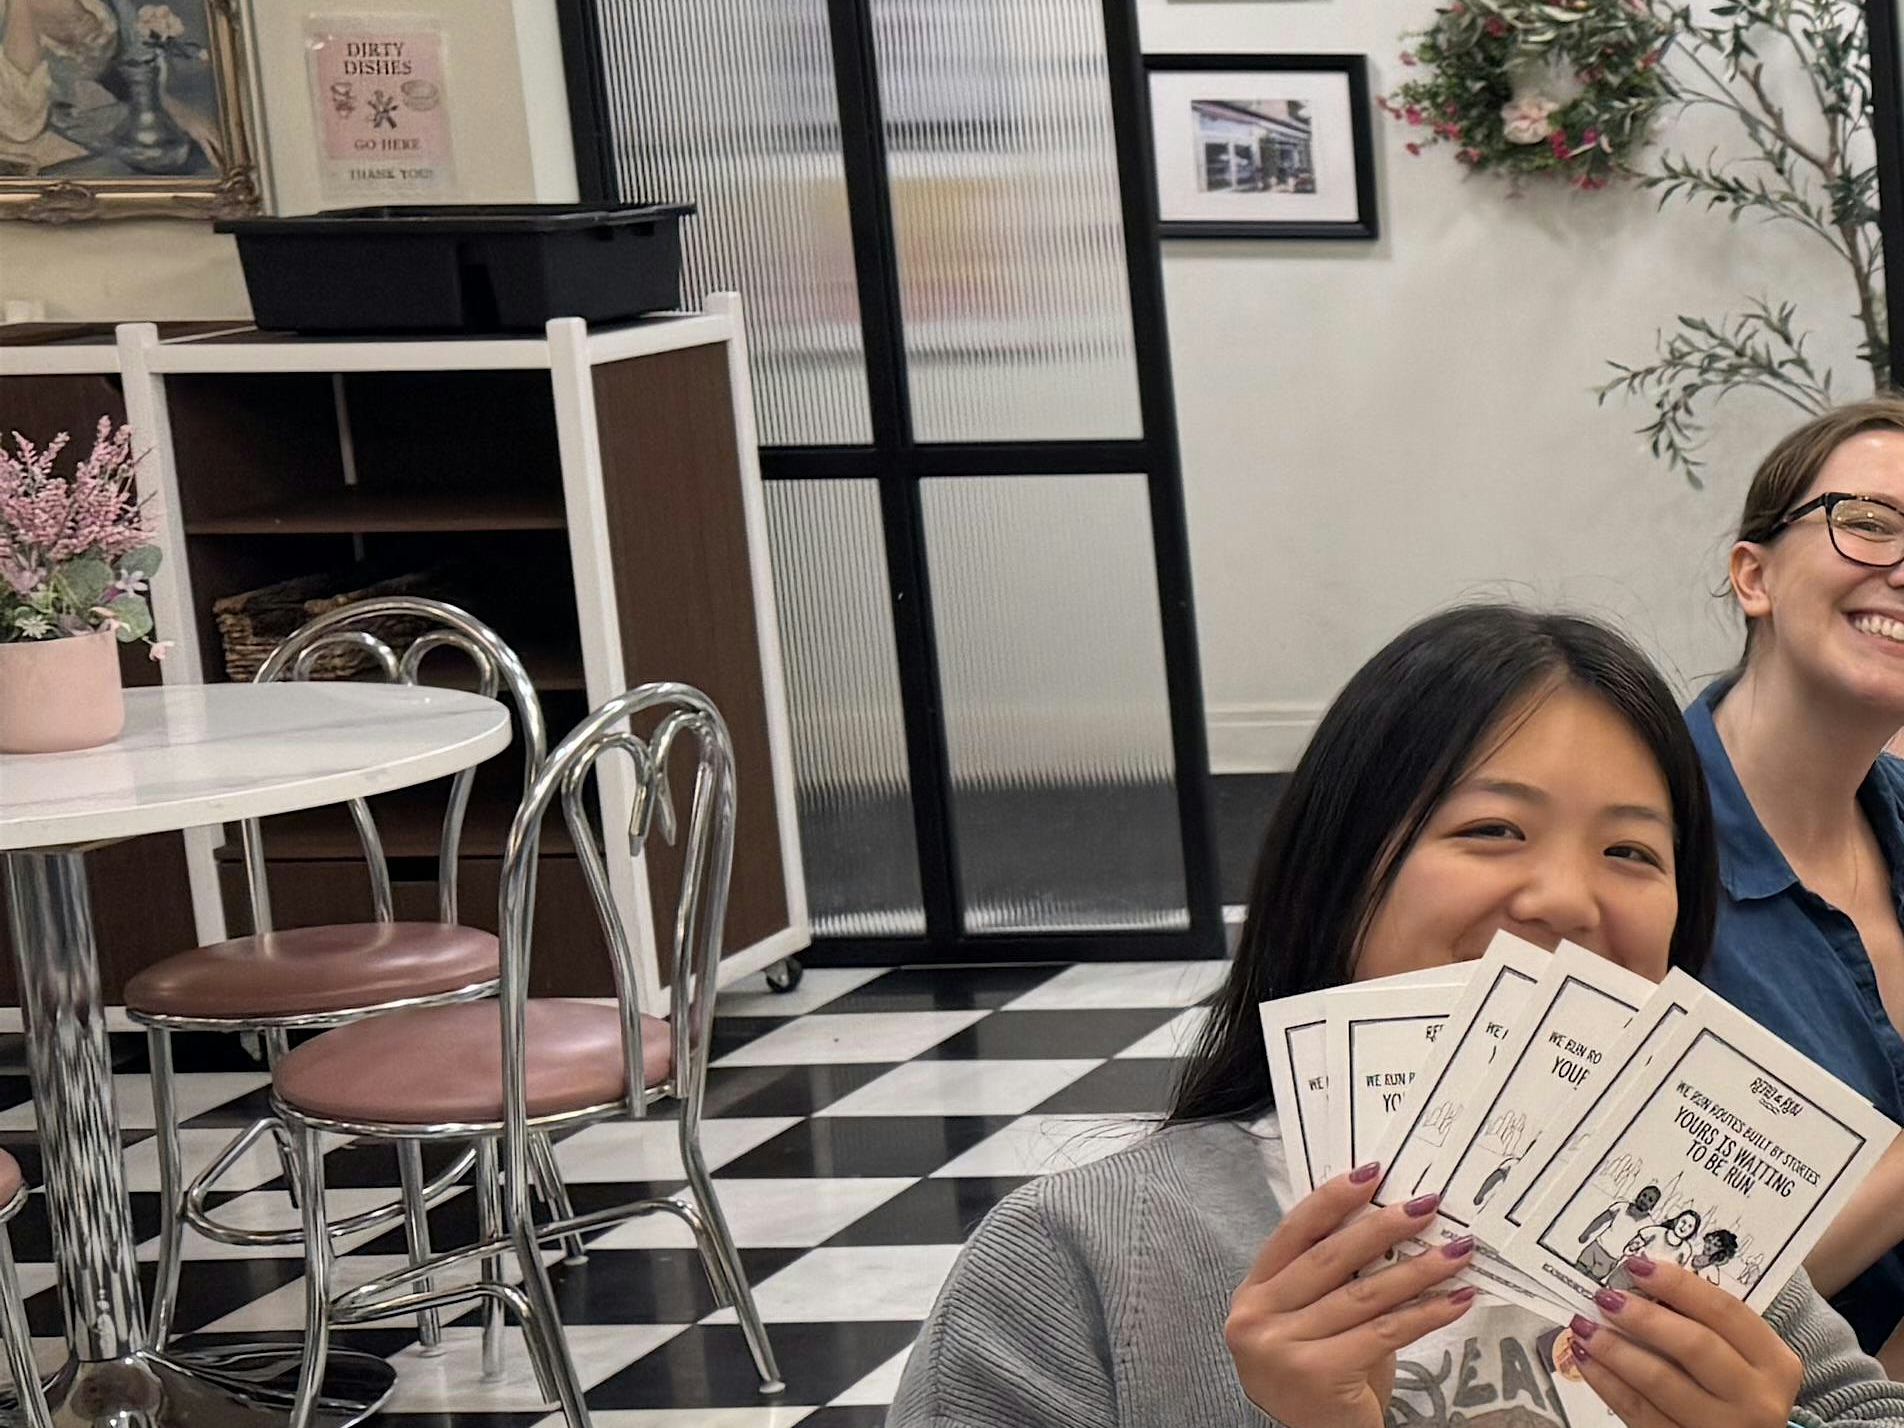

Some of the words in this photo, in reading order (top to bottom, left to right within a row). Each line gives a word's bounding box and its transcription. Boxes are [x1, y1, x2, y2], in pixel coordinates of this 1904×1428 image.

[347, 42, 405, 58] DIRTY
[344, 60, 412, 76] DISHES
[354, 139, 376, 151] GO
[382, 138, 420, 151] HERE
[1709, 1102, 1746, 1134] ROUTES
[1742, 1127, 1773, 1153] BUILT
[1771, 1143, 1786, 1160] BY
[1673, 1105, 1718, 1145] YOURS
[1714, 1134, 1736, 1158] IS
[1732, 1146, 1796, 1198] WAITING
[1685, 1139, 1706, 1163] TO
[1703, 1152, 1727, 1177] BE
